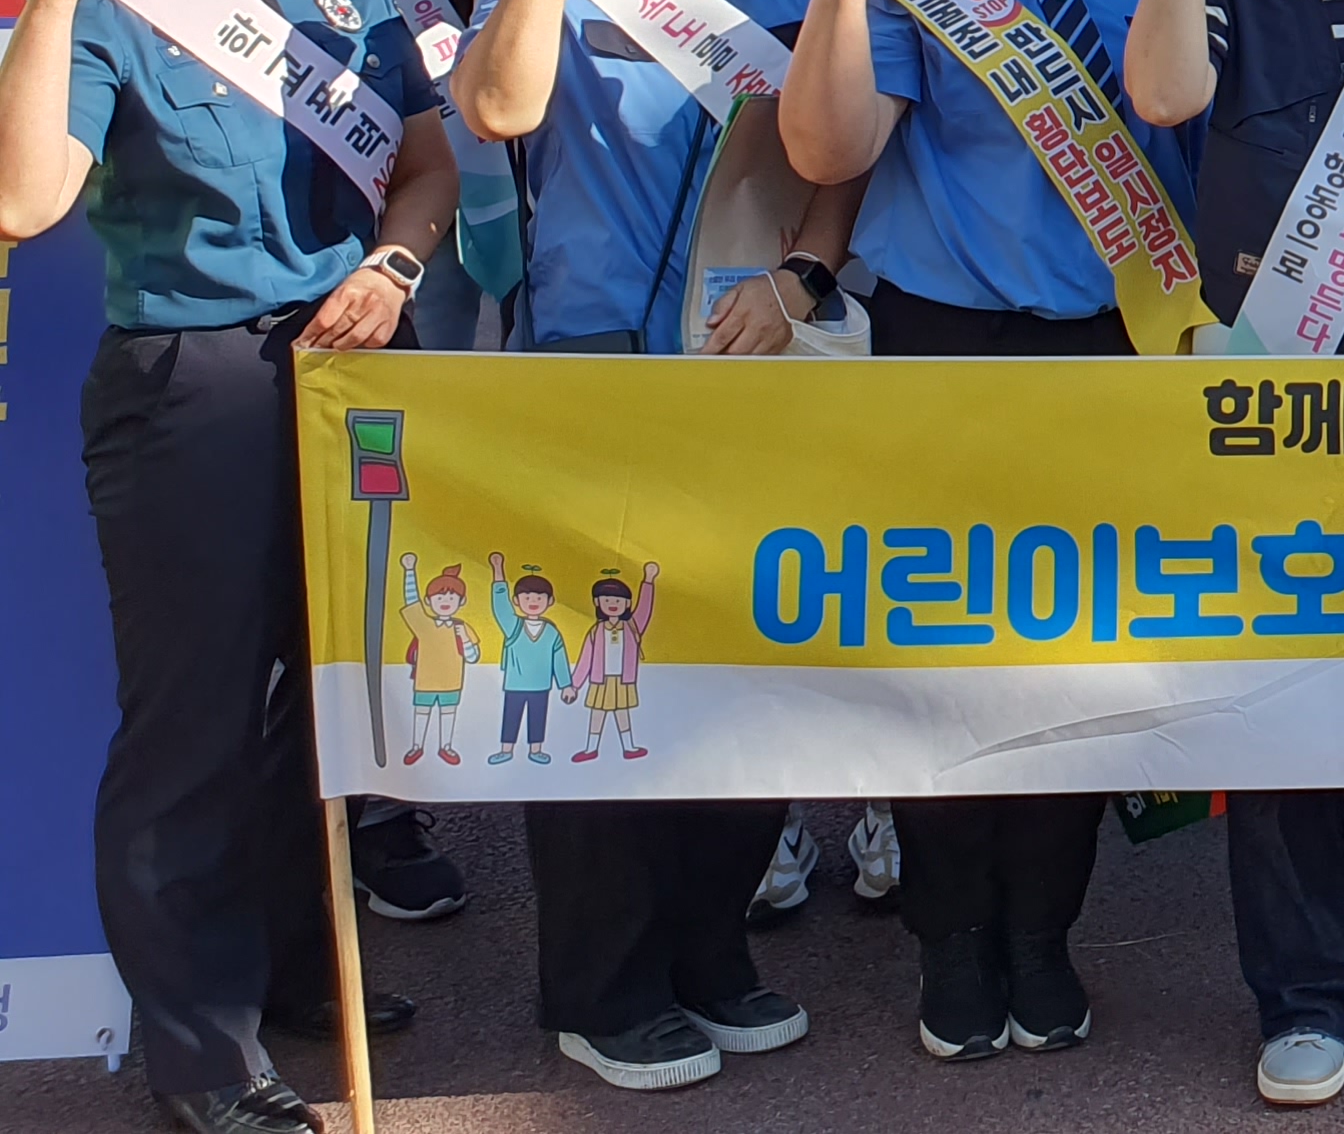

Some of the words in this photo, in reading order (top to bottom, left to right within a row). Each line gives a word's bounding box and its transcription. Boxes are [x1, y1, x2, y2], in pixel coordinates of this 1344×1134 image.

[217, 12, 392, 159] 학교폭력
[988, 59, 1039, 104] 내
[1024, 105, 1137, 265] 횡단보도
[1005, 21, 1107, 132] 반드시
[1094, 133, 1198, 292] 일시정지
